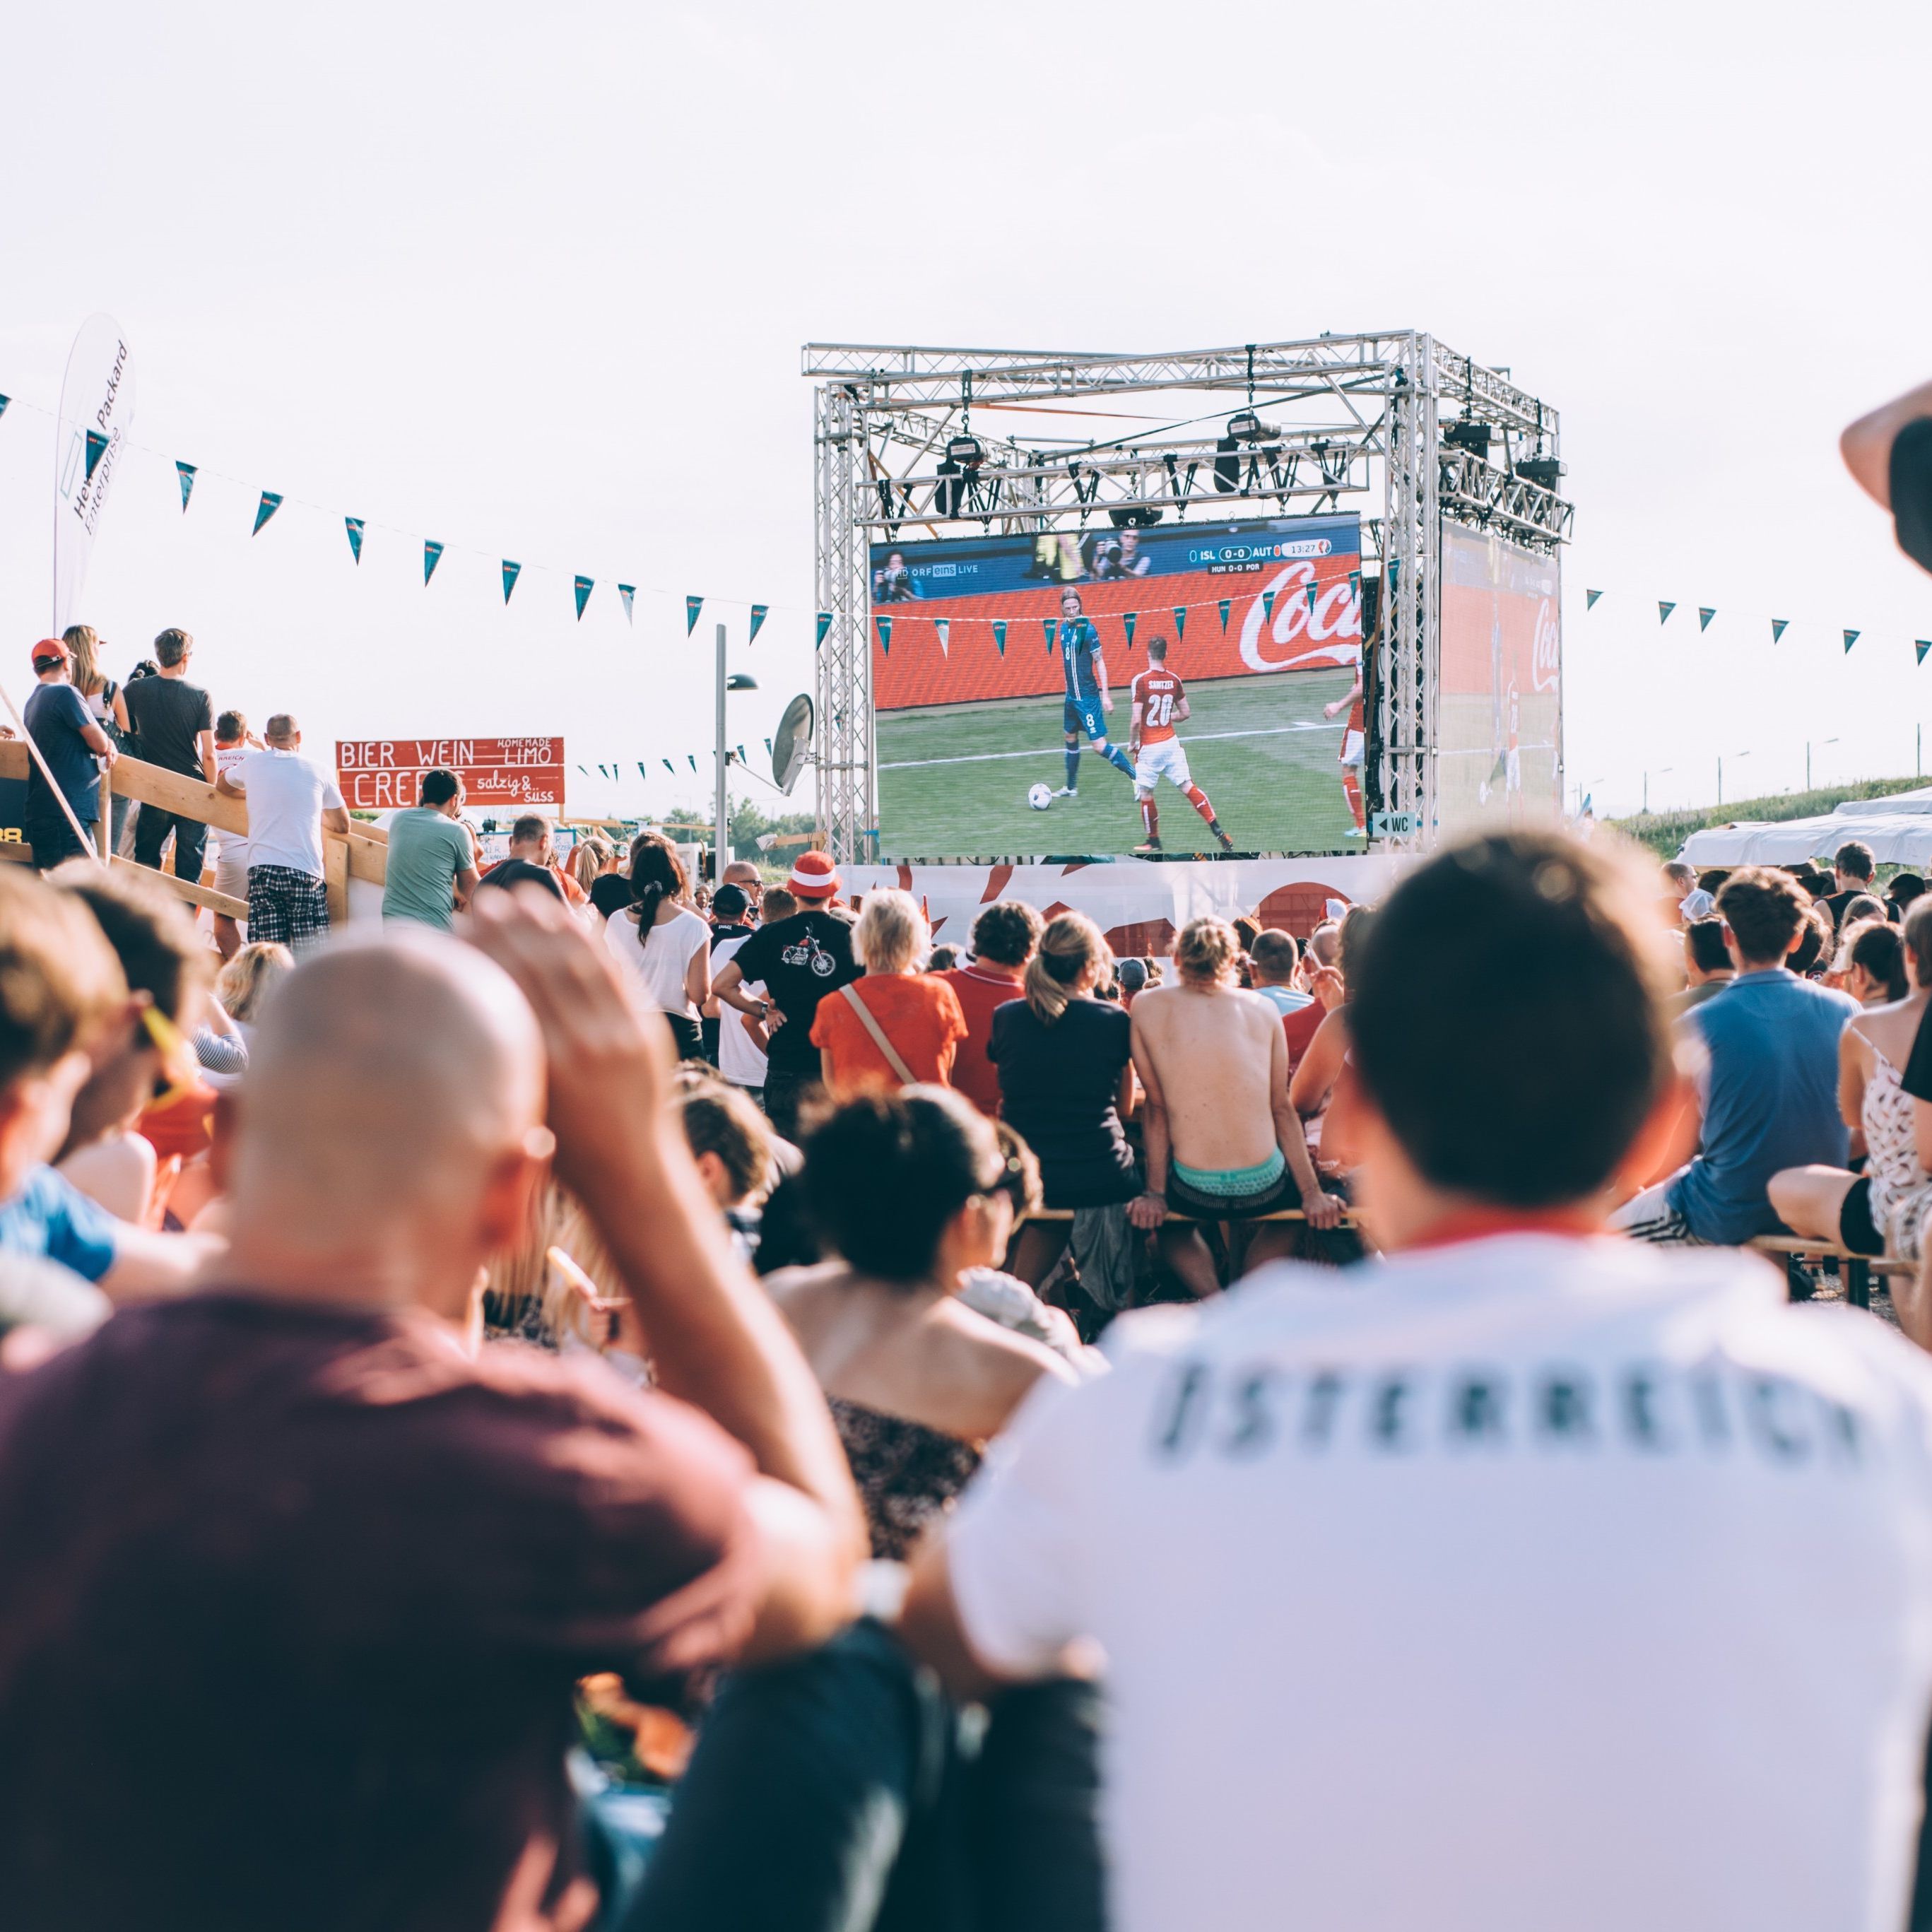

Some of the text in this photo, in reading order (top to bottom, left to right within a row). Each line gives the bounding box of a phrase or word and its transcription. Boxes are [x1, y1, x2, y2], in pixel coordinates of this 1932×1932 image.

[96, 339, 127, 430] Packard
[84, 427, 121, 535] Enterprise
[1201, 545, 1315, 560] ISL 0-0 AUT 13:27
[912, 567, 932, 576] ORF
[933, 565, 955, 576] eins
[958, 565, 979, 574] LIVE
[1085, 714, 1095, 727] 8
[1146, 694, 1174, 727] 20
[341, 741, 474, 767] BIER WEIN
[497, 738, 552, 748] HOMEMADE
[504, 747, 552, 765] LIMO
[354, 770, 466, 807] CREPS
[477, 770, 521, 797] salzig
[1391, 817, 1408, 832] WC
